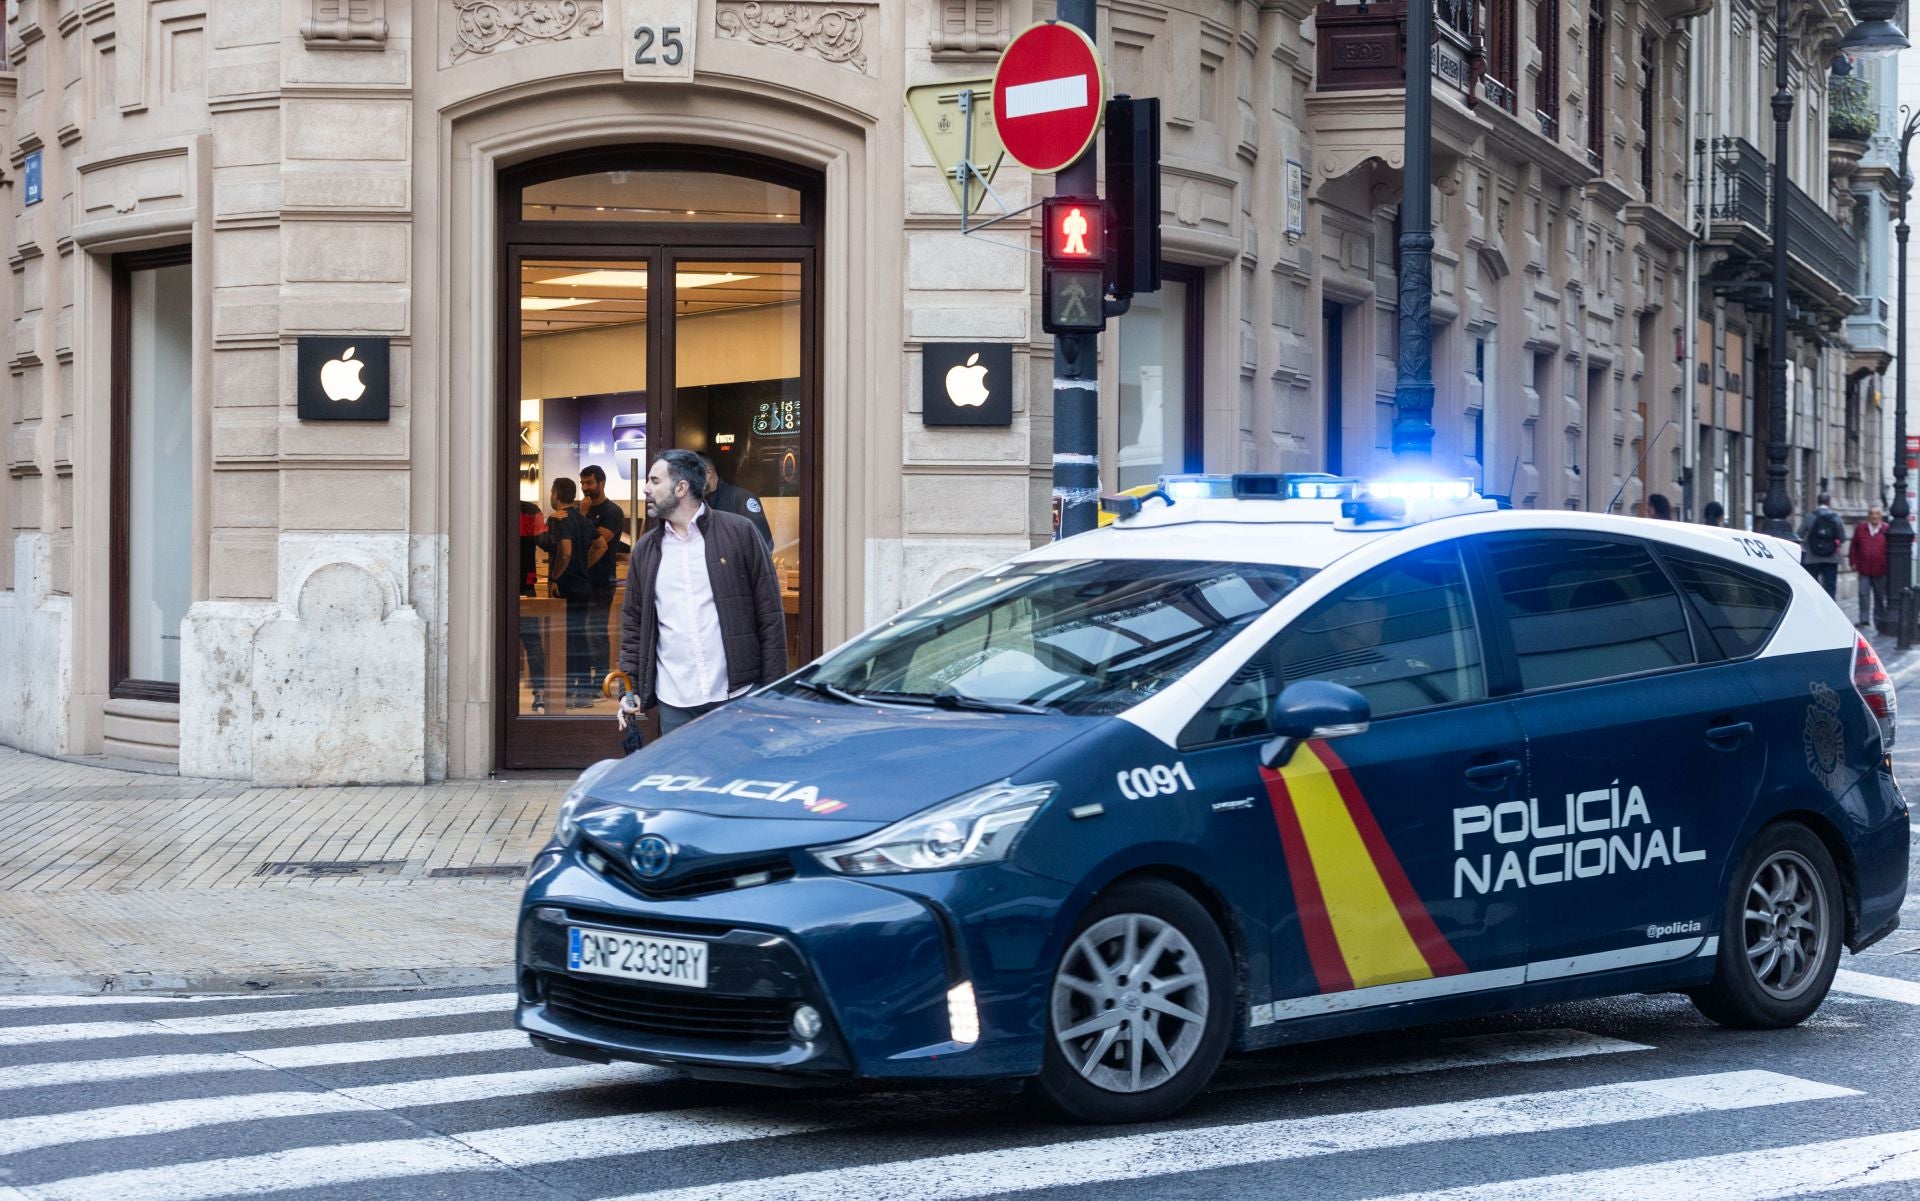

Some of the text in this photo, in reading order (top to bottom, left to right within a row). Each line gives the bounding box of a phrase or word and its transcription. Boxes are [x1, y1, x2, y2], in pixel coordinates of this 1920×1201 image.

[633, 26, 684, 66] 25
[628, 774, 820, 806] POLICÍA
[1453, 778, 1652, 851] POLICÍA
[1453, 826, 1707, 898] NACIONAL
[1646, 920, 1702, 939] @policia
